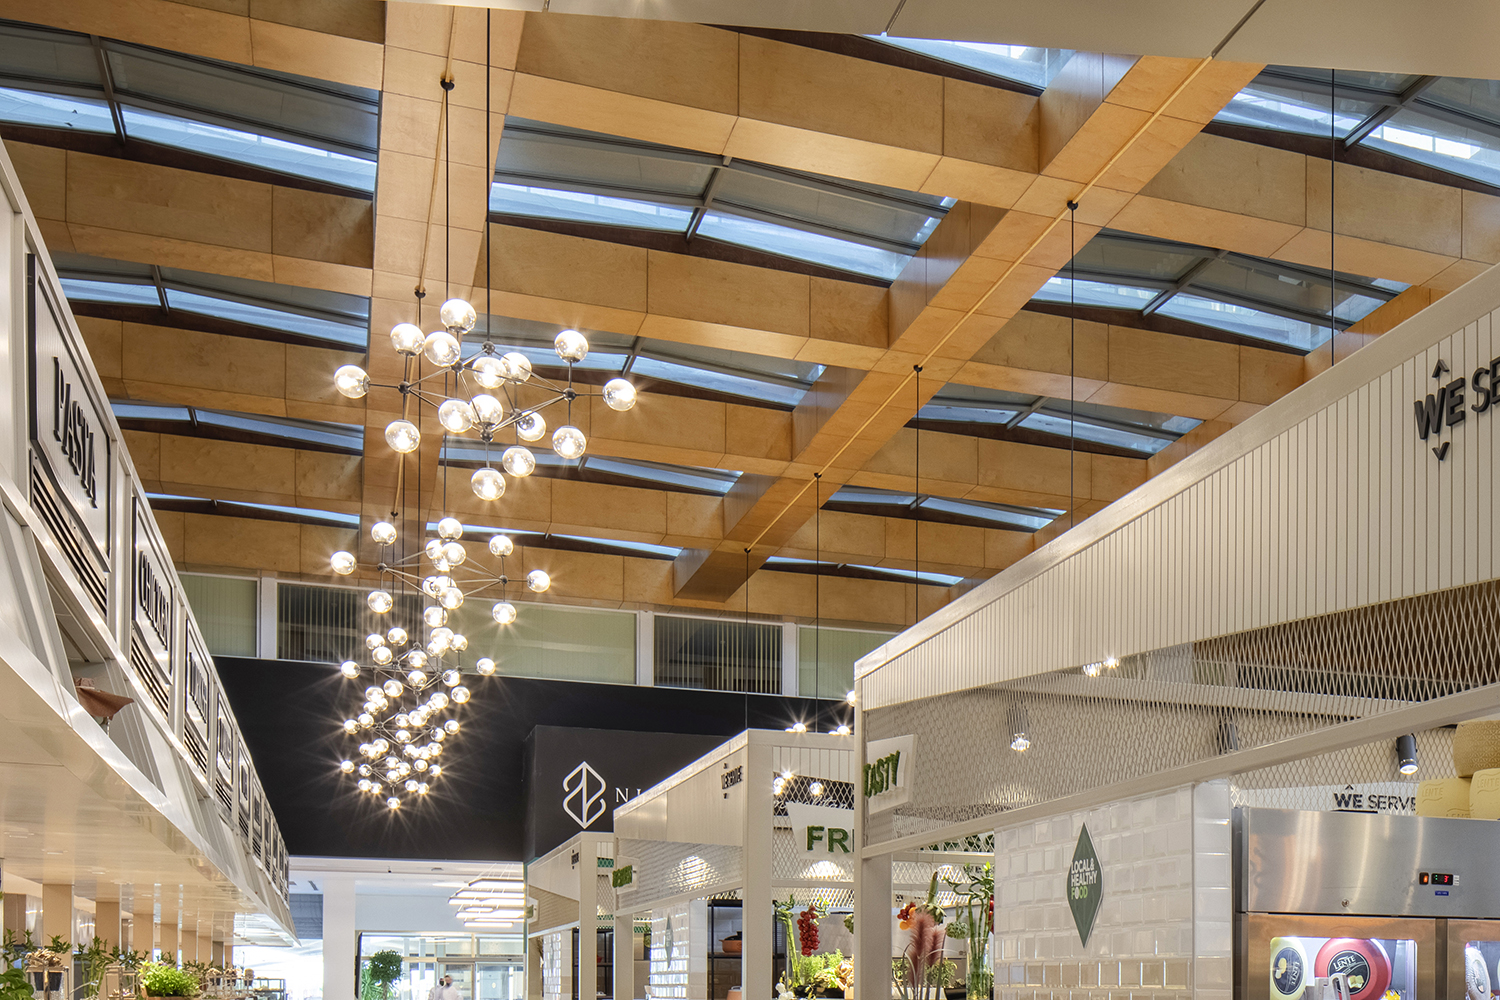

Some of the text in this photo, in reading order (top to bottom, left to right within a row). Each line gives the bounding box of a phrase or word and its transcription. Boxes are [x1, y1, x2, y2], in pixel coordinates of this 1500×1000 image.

[1414, 377, 1465, 440] WE
[53, 356, 98, 509] PASTA
[863, 750, 901, 798] TASTY
[1333, 792, 1363, 809] WE
[1071, 858, 1089, 873] LOCAL
[1071, 870, 1098, 887] HEALTHY
[1071, 885, 1088, 900] FOOD
[1332, 954, 1357, 971] LENTE
